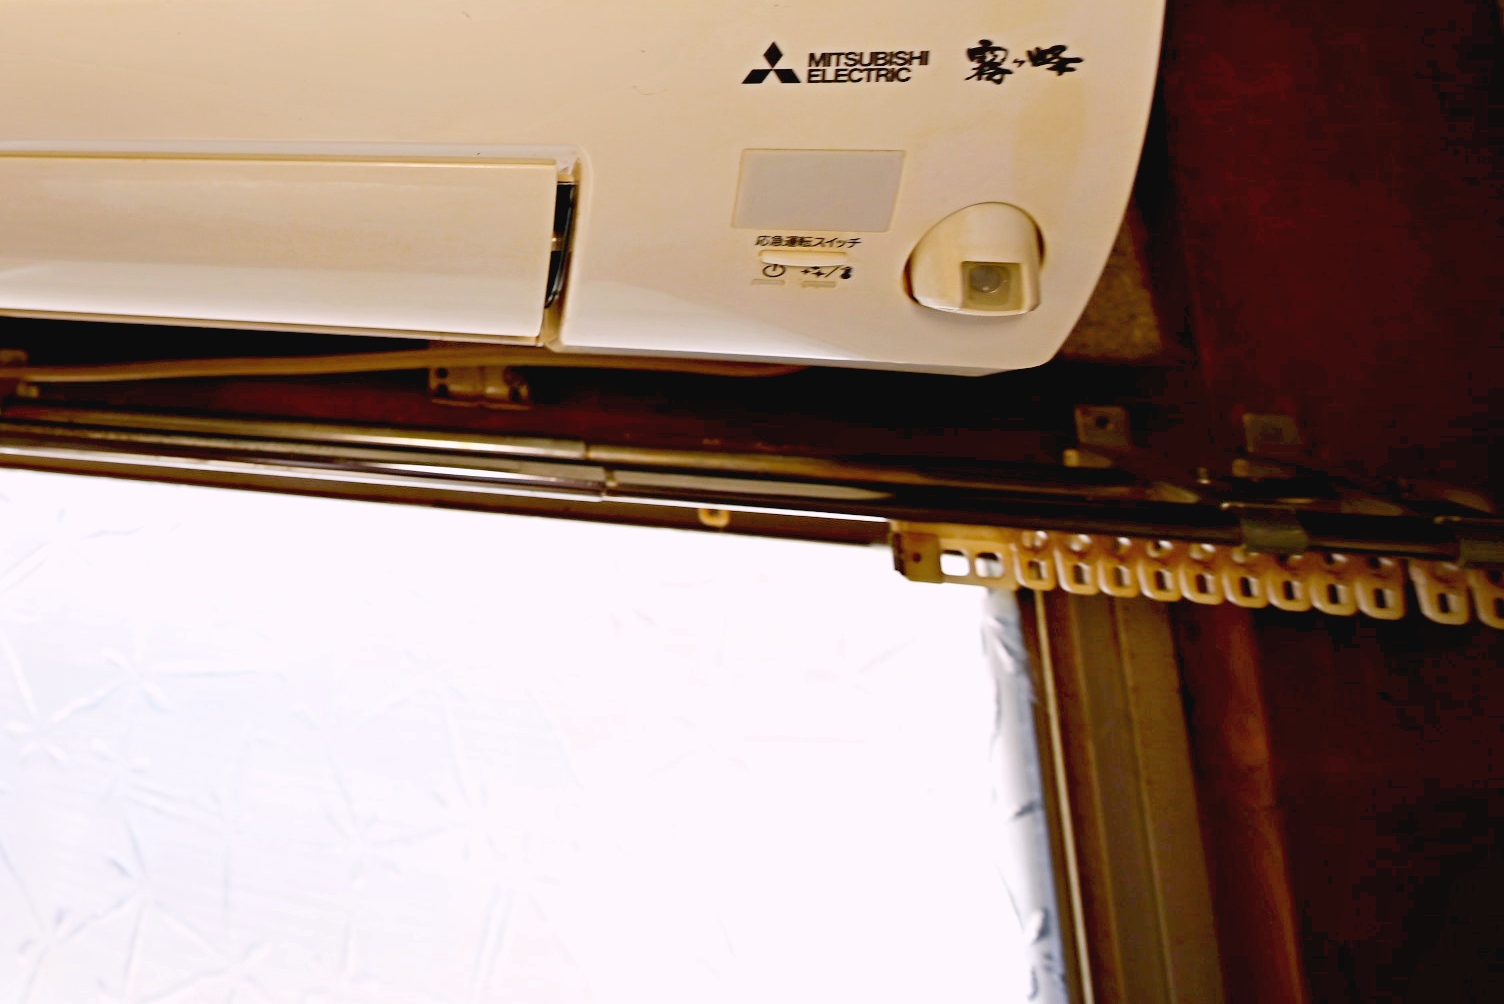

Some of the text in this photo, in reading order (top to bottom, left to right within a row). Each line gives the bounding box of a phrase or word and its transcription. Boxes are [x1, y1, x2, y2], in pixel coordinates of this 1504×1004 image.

[807, 50, 930, 67] MITSUBISHI
[807, 68, 912, 83] ELECTRIC
[754, 235, 862, 248] 応急運転スイッチ
